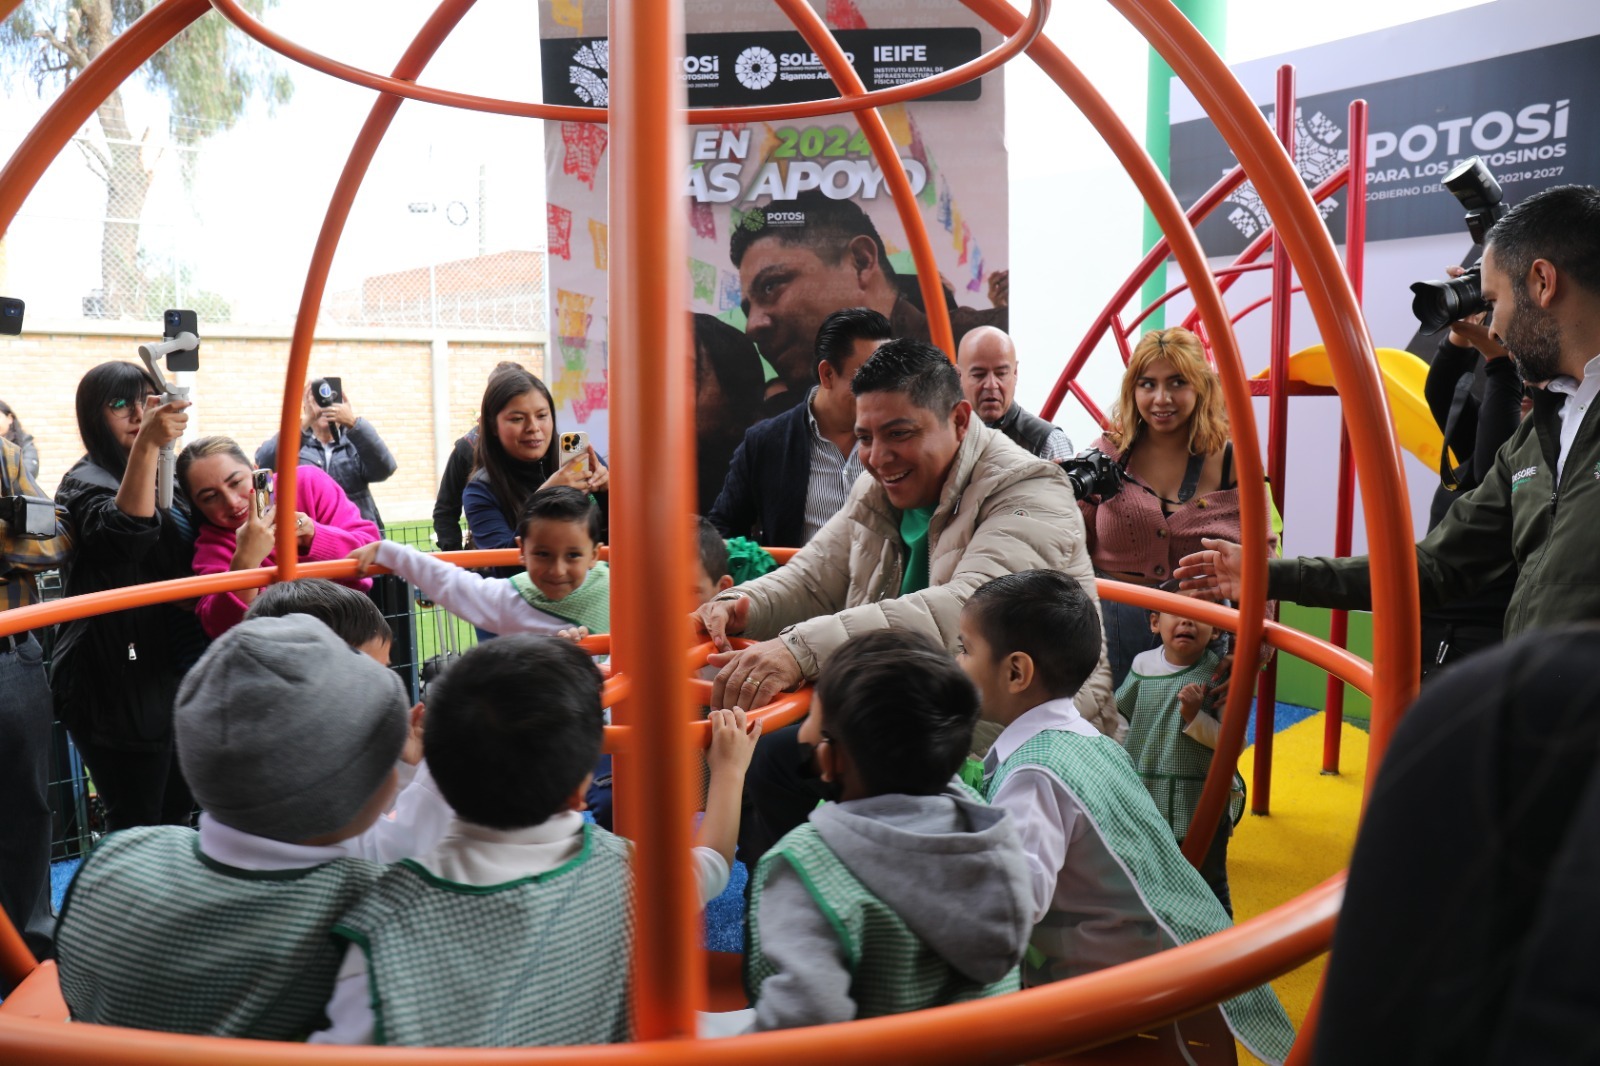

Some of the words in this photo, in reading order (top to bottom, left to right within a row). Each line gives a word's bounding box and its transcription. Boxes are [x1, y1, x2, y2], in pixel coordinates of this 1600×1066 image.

[779, 52, 855, 66] SOLED
[874, 45, 927, 62] IEIFE
[674, 55, 719, 73] TOSí
[780, 72, 816, 81] Sigamos
[693, 130, 751, 160] EN
[774, 126, 873, 158] 2024
[1366, 167, 1411, 185] PARA
[1414, 161, 1449, 178] LOS
[1453, 143, 1567, 168] TOSINOS
[682, 162, 742, 202] ÁS
[746, 159, 927, 201] APOYO
[1422, 184, 1445, 194] DEL
